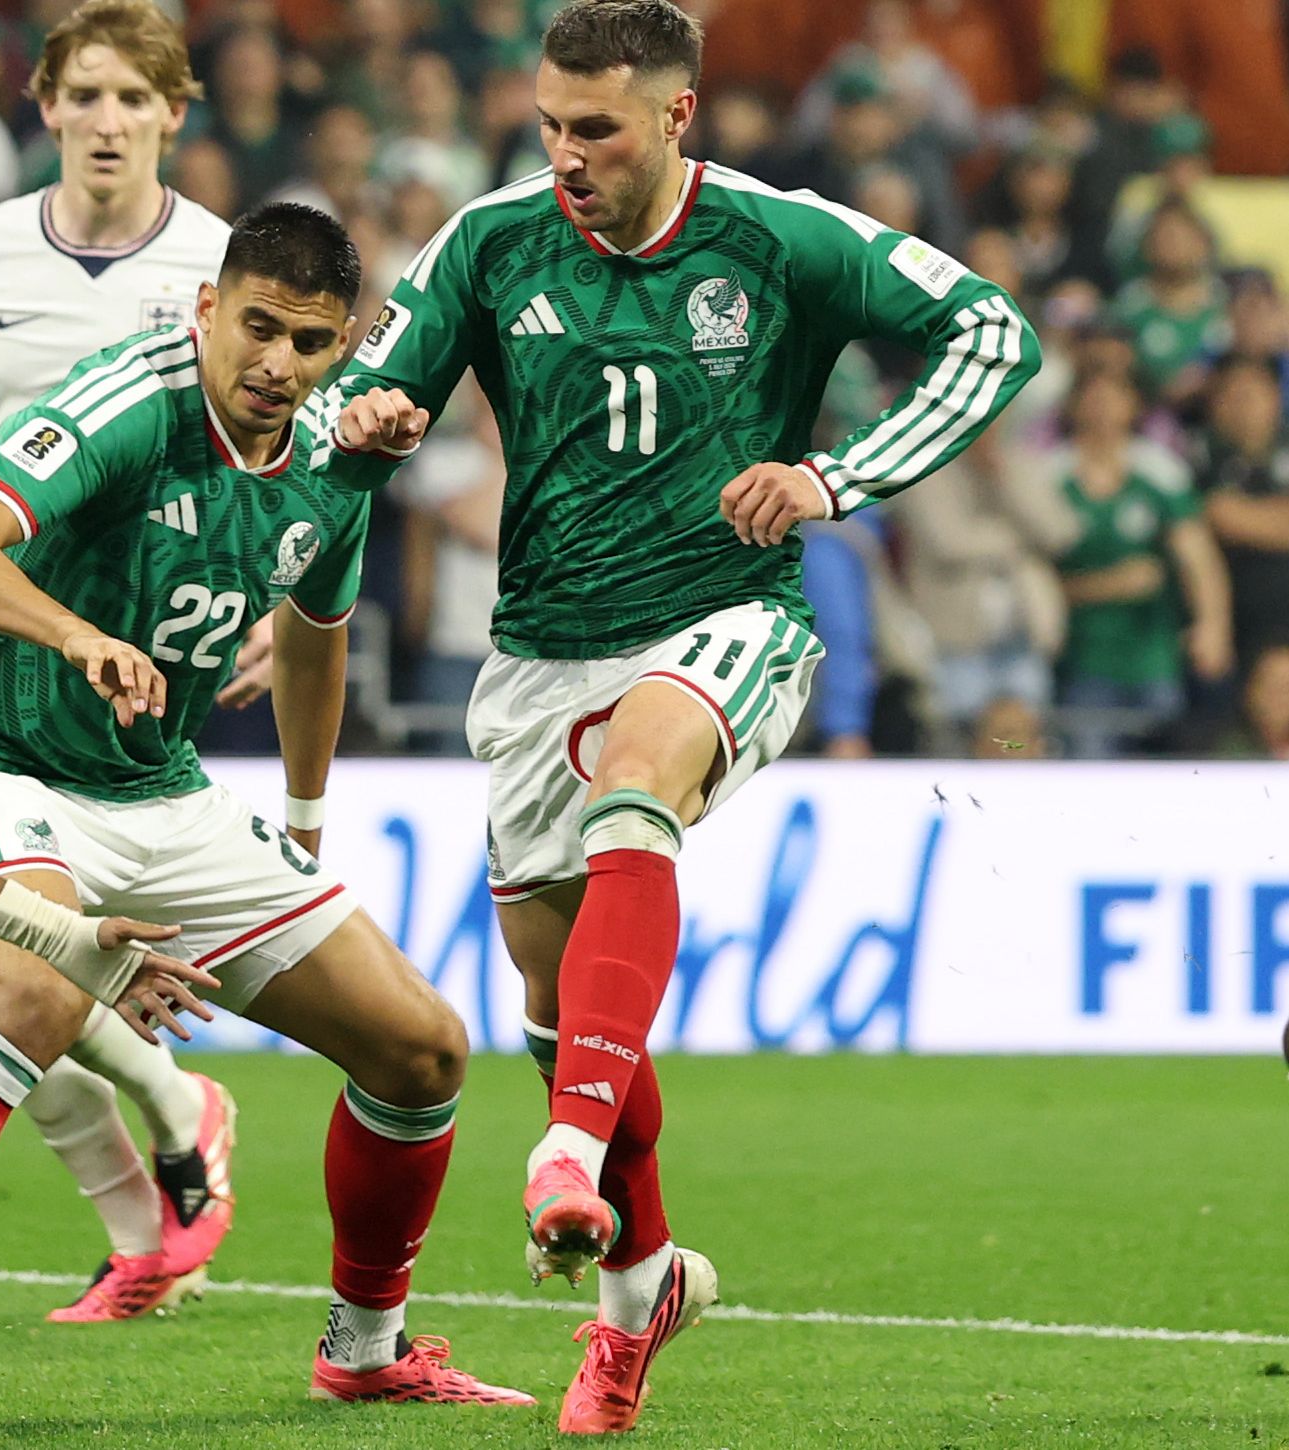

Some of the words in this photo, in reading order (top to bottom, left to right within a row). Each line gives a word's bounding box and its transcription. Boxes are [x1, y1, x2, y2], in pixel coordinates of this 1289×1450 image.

[694, 334, 747, 348] MÉXICO
[602, 364, 658, 455] 11
[152, 583, 247, 669] 22
[678, 632, 747, 681] 11
